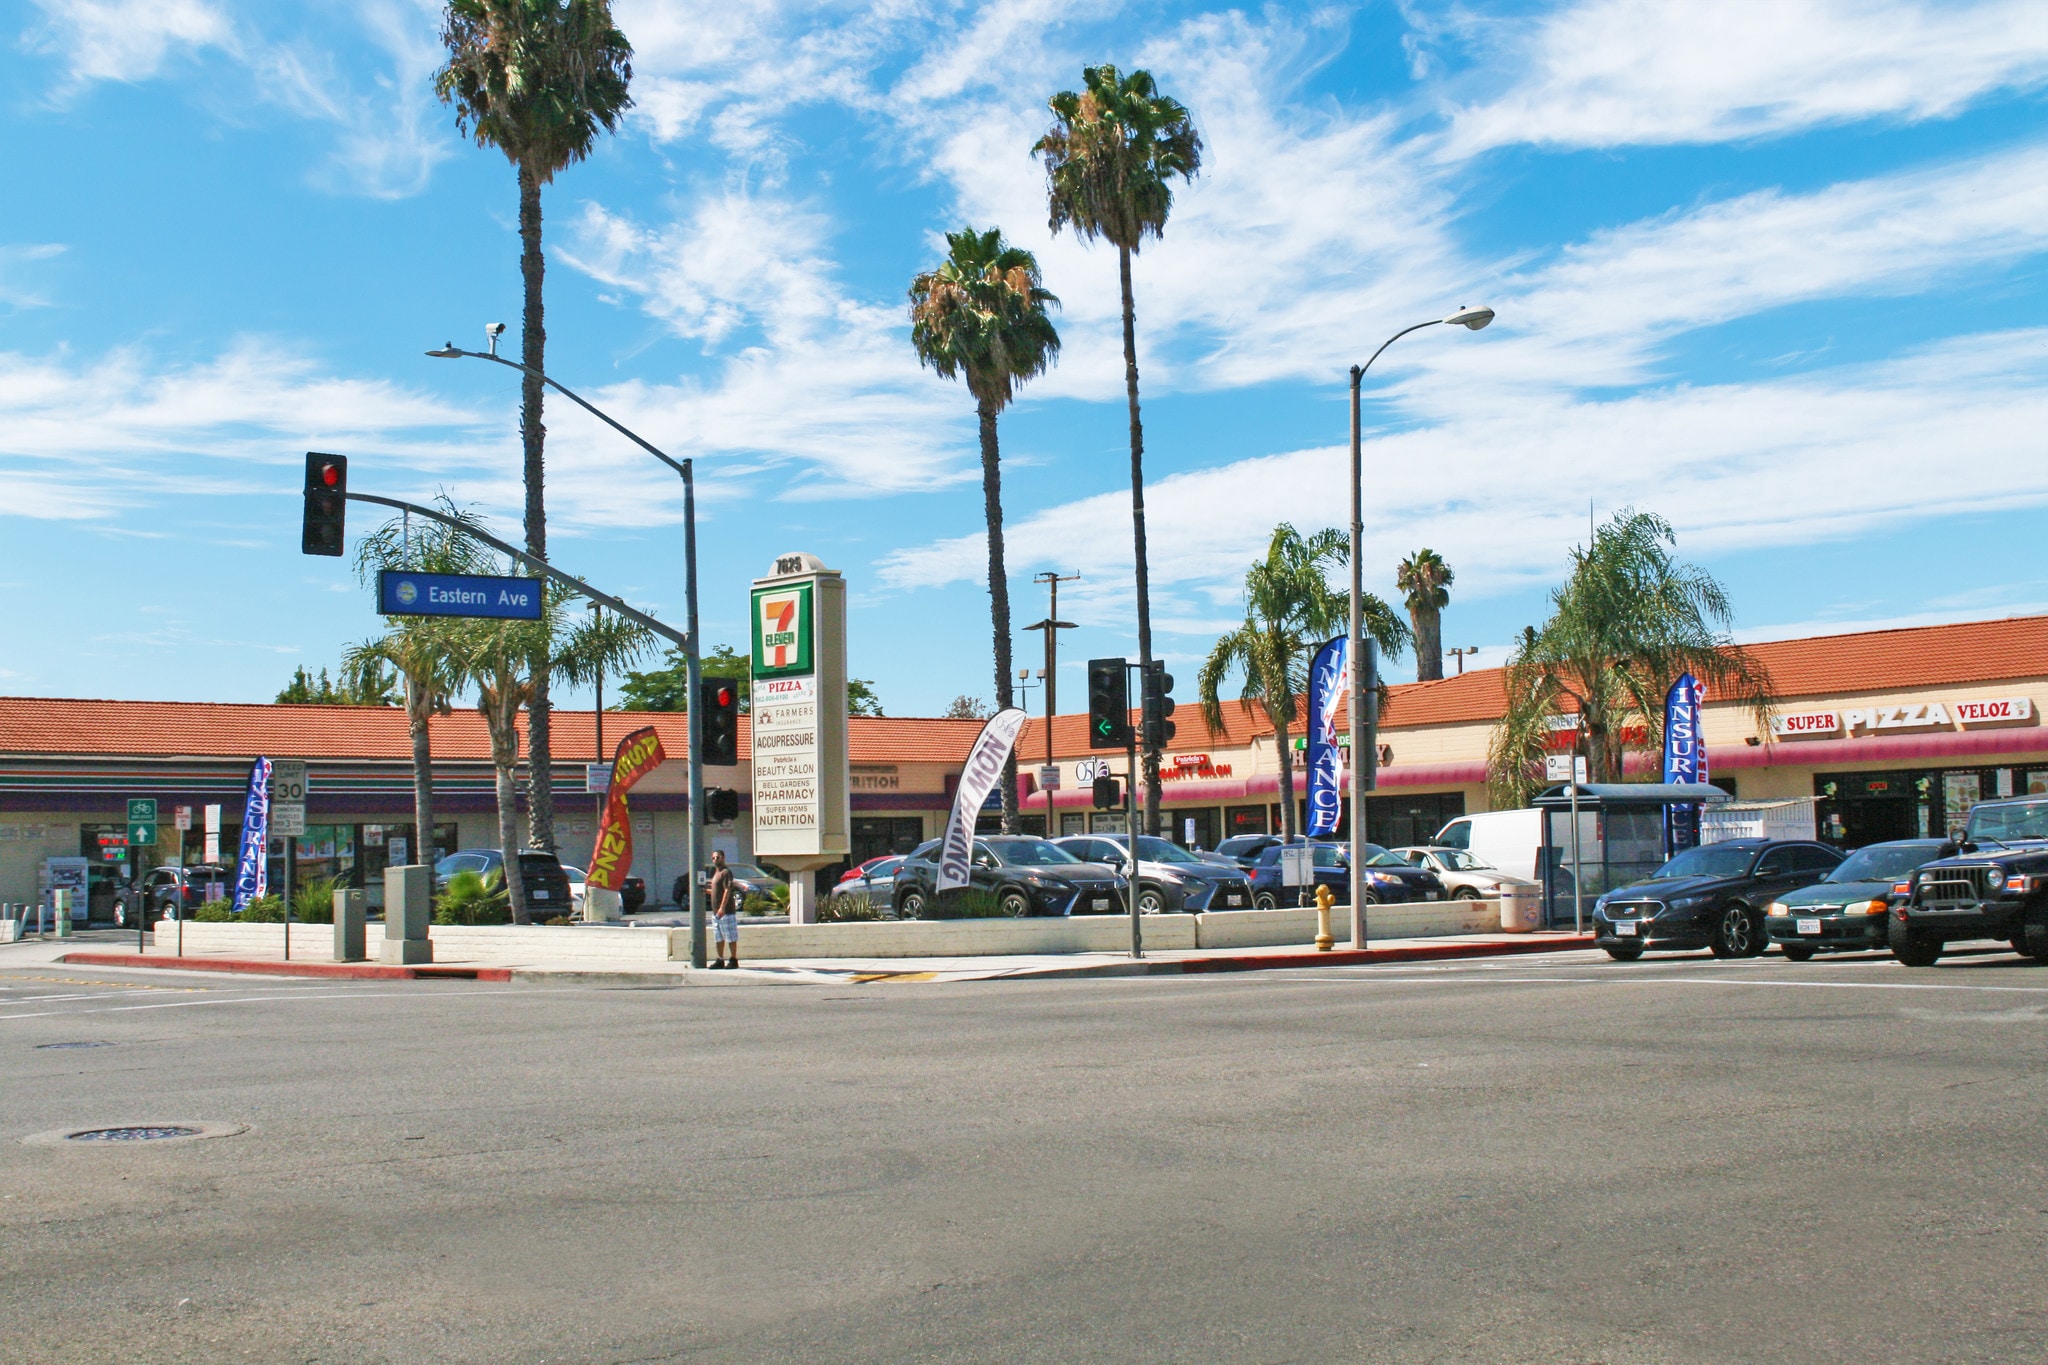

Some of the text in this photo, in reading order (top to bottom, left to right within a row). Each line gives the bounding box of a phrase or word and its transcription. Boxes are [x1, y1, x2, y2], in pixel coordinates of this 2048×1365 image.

[429, 586, 528, 607] Eastern Ave
[766, 600, 795, 667] 7
[768, 680, 802, 693] PIZZA
[776, 707, 814, 718] FARMERS
[1787, 701, 2011, 731] SUPER PIZZA VELOZ
[757, 732, 814, 749] ACCUPRESSURE
[757, 763, 814, 777] BEAUTY SALON
[966, 731, 1008, 798] NOW
[278, 783, 302, 798] 30
[763, 780, 810, 789] BELL GARDENS
[758, 788, 815, 801] PHARMACY
[766, 805, 808, 814] SUPER MOMS
[286, 819, 290, 828] 3
[760, 814, 815, 826] NUTRITION
